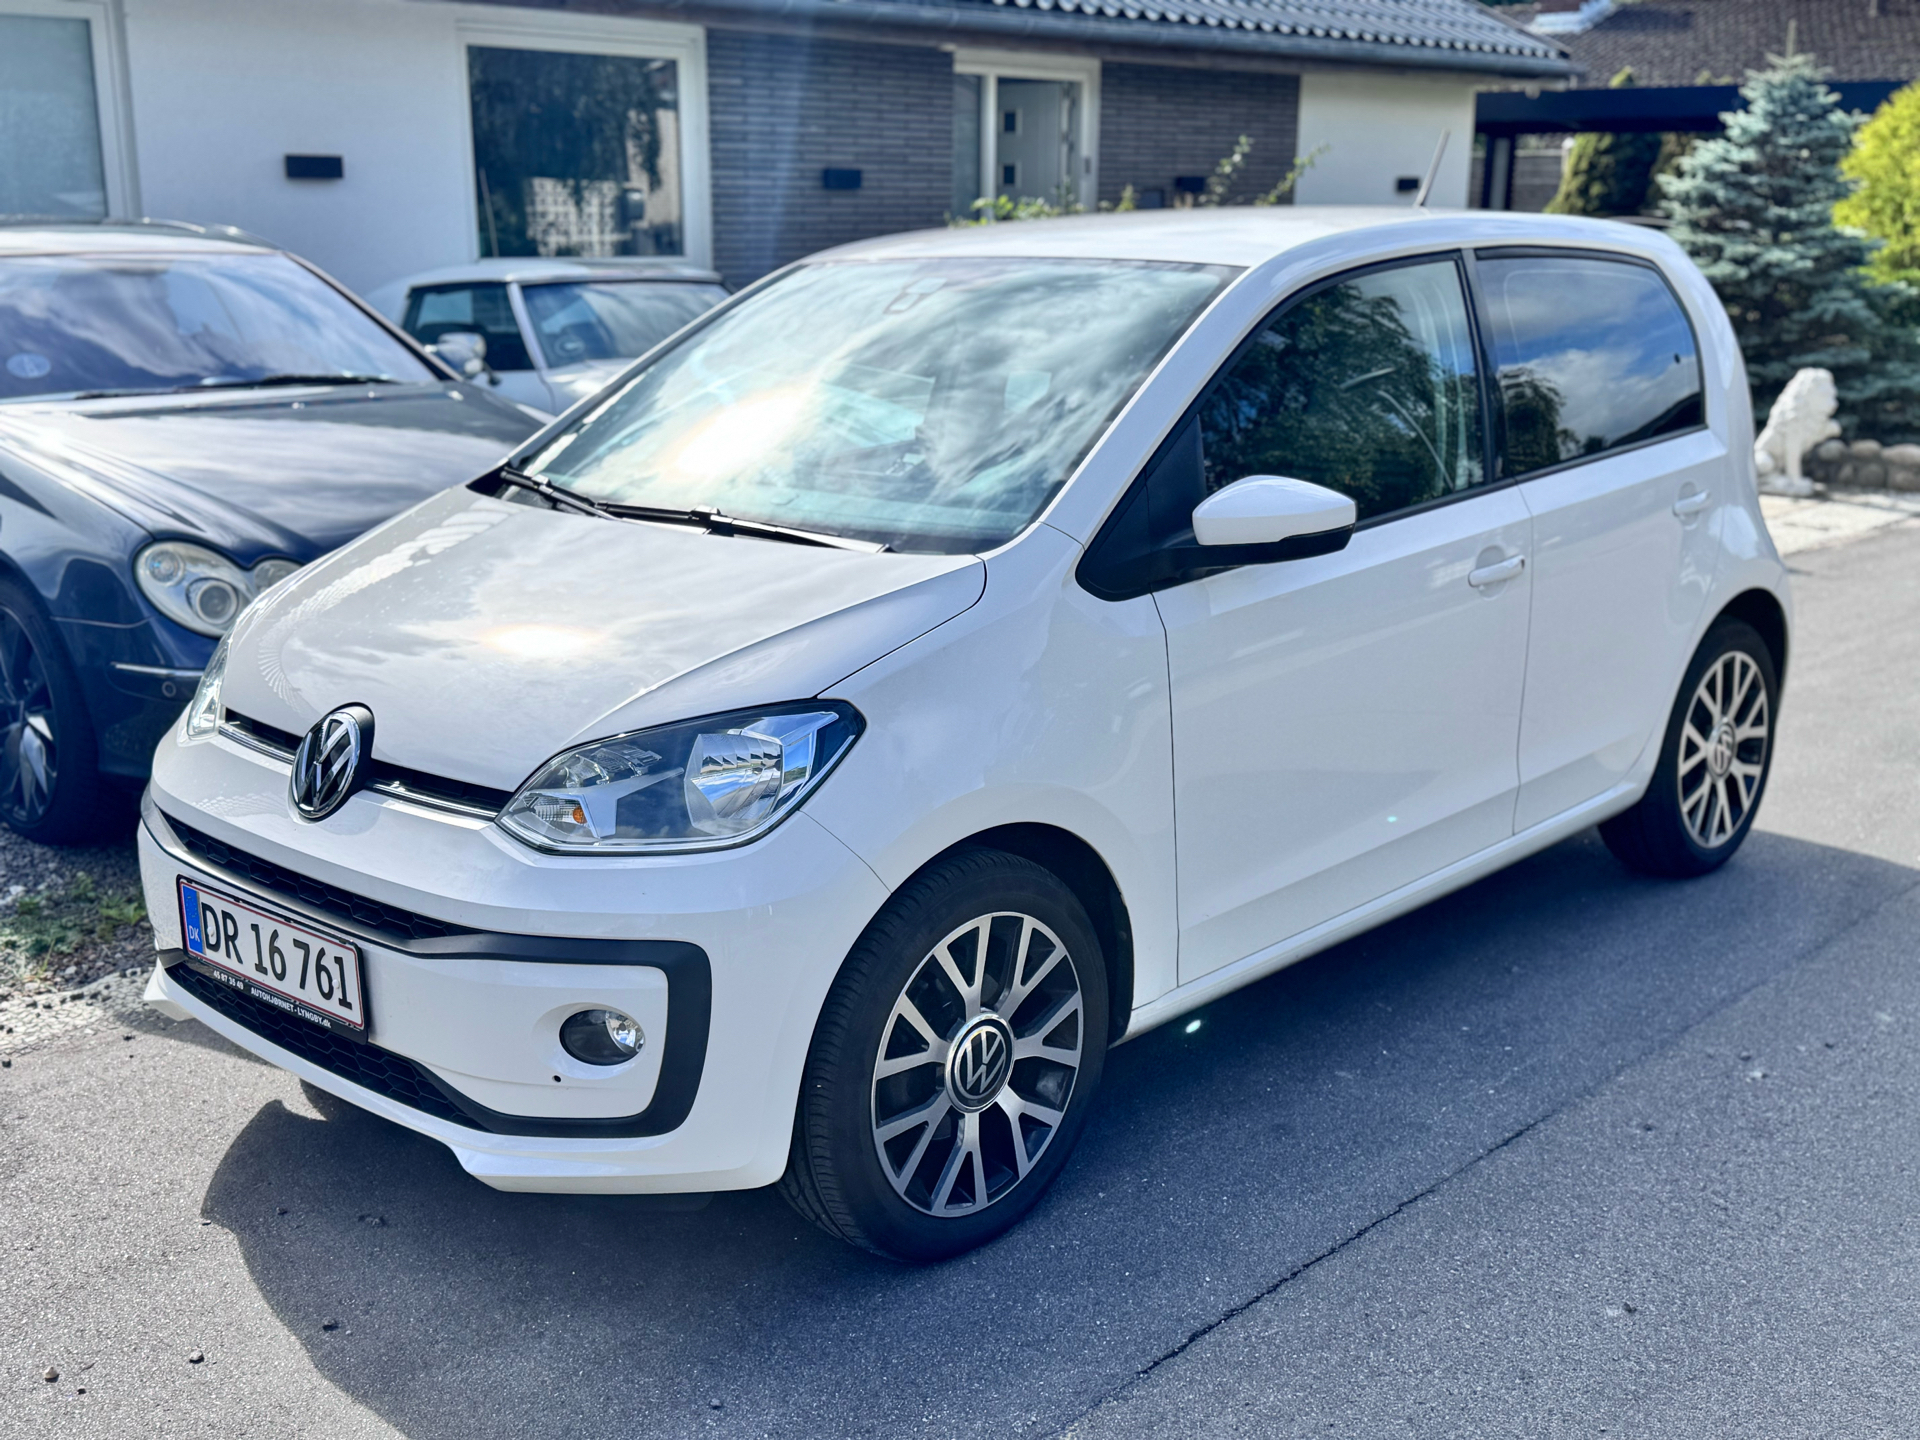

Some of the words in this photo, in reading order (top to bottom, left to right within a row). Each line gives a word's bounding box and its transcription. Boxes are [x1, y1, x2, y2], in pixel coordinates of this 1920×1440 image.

[293, 712, 360, 816] VW
[188, 925, 200, 943] DK
[201, 902, 243, 964] DR
[250, 924, 287, 982] 16
[293, 938, 353, 1010] 761
[957, 1027, 1007, 1097] VW
